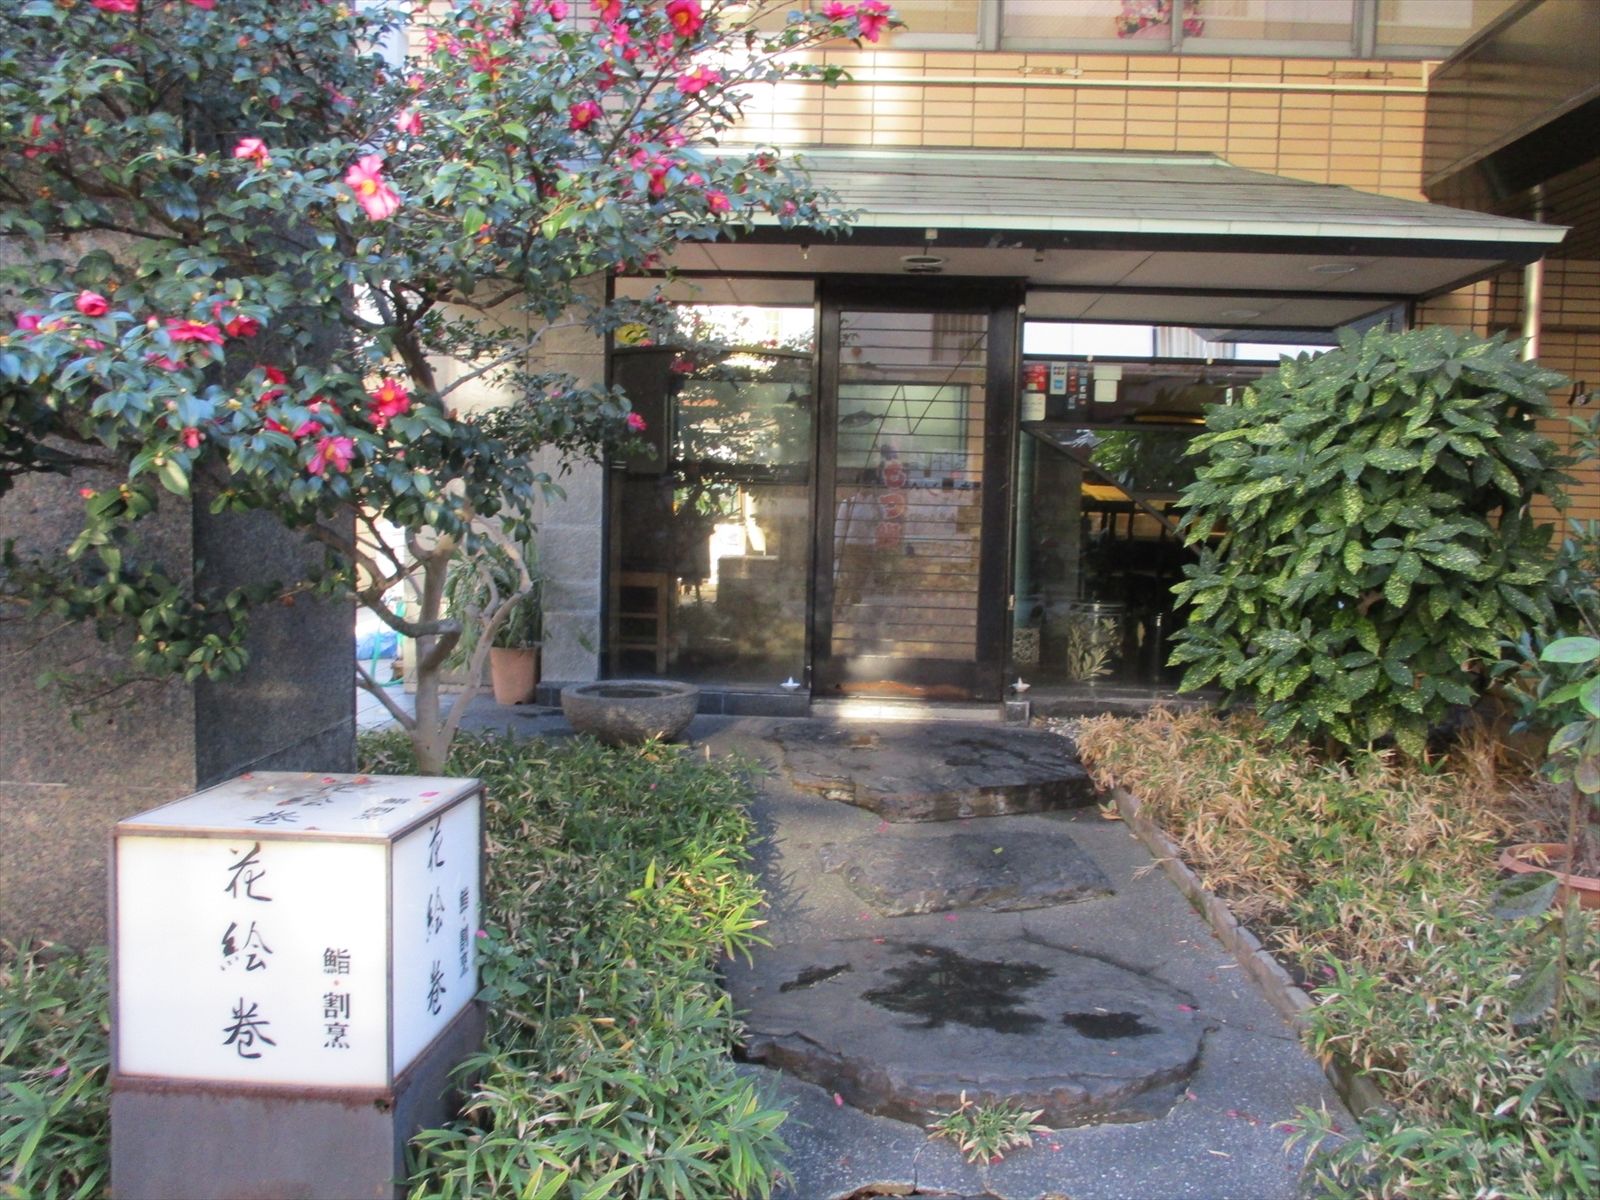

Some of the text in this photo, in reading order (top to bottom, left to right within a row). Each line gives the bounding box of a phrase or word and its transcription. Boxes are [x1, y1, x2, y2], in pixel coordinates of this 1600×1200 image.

[221, 841, 276, 1059] 花絵巻
[426, 815, 447, 1016] 花絵巻
